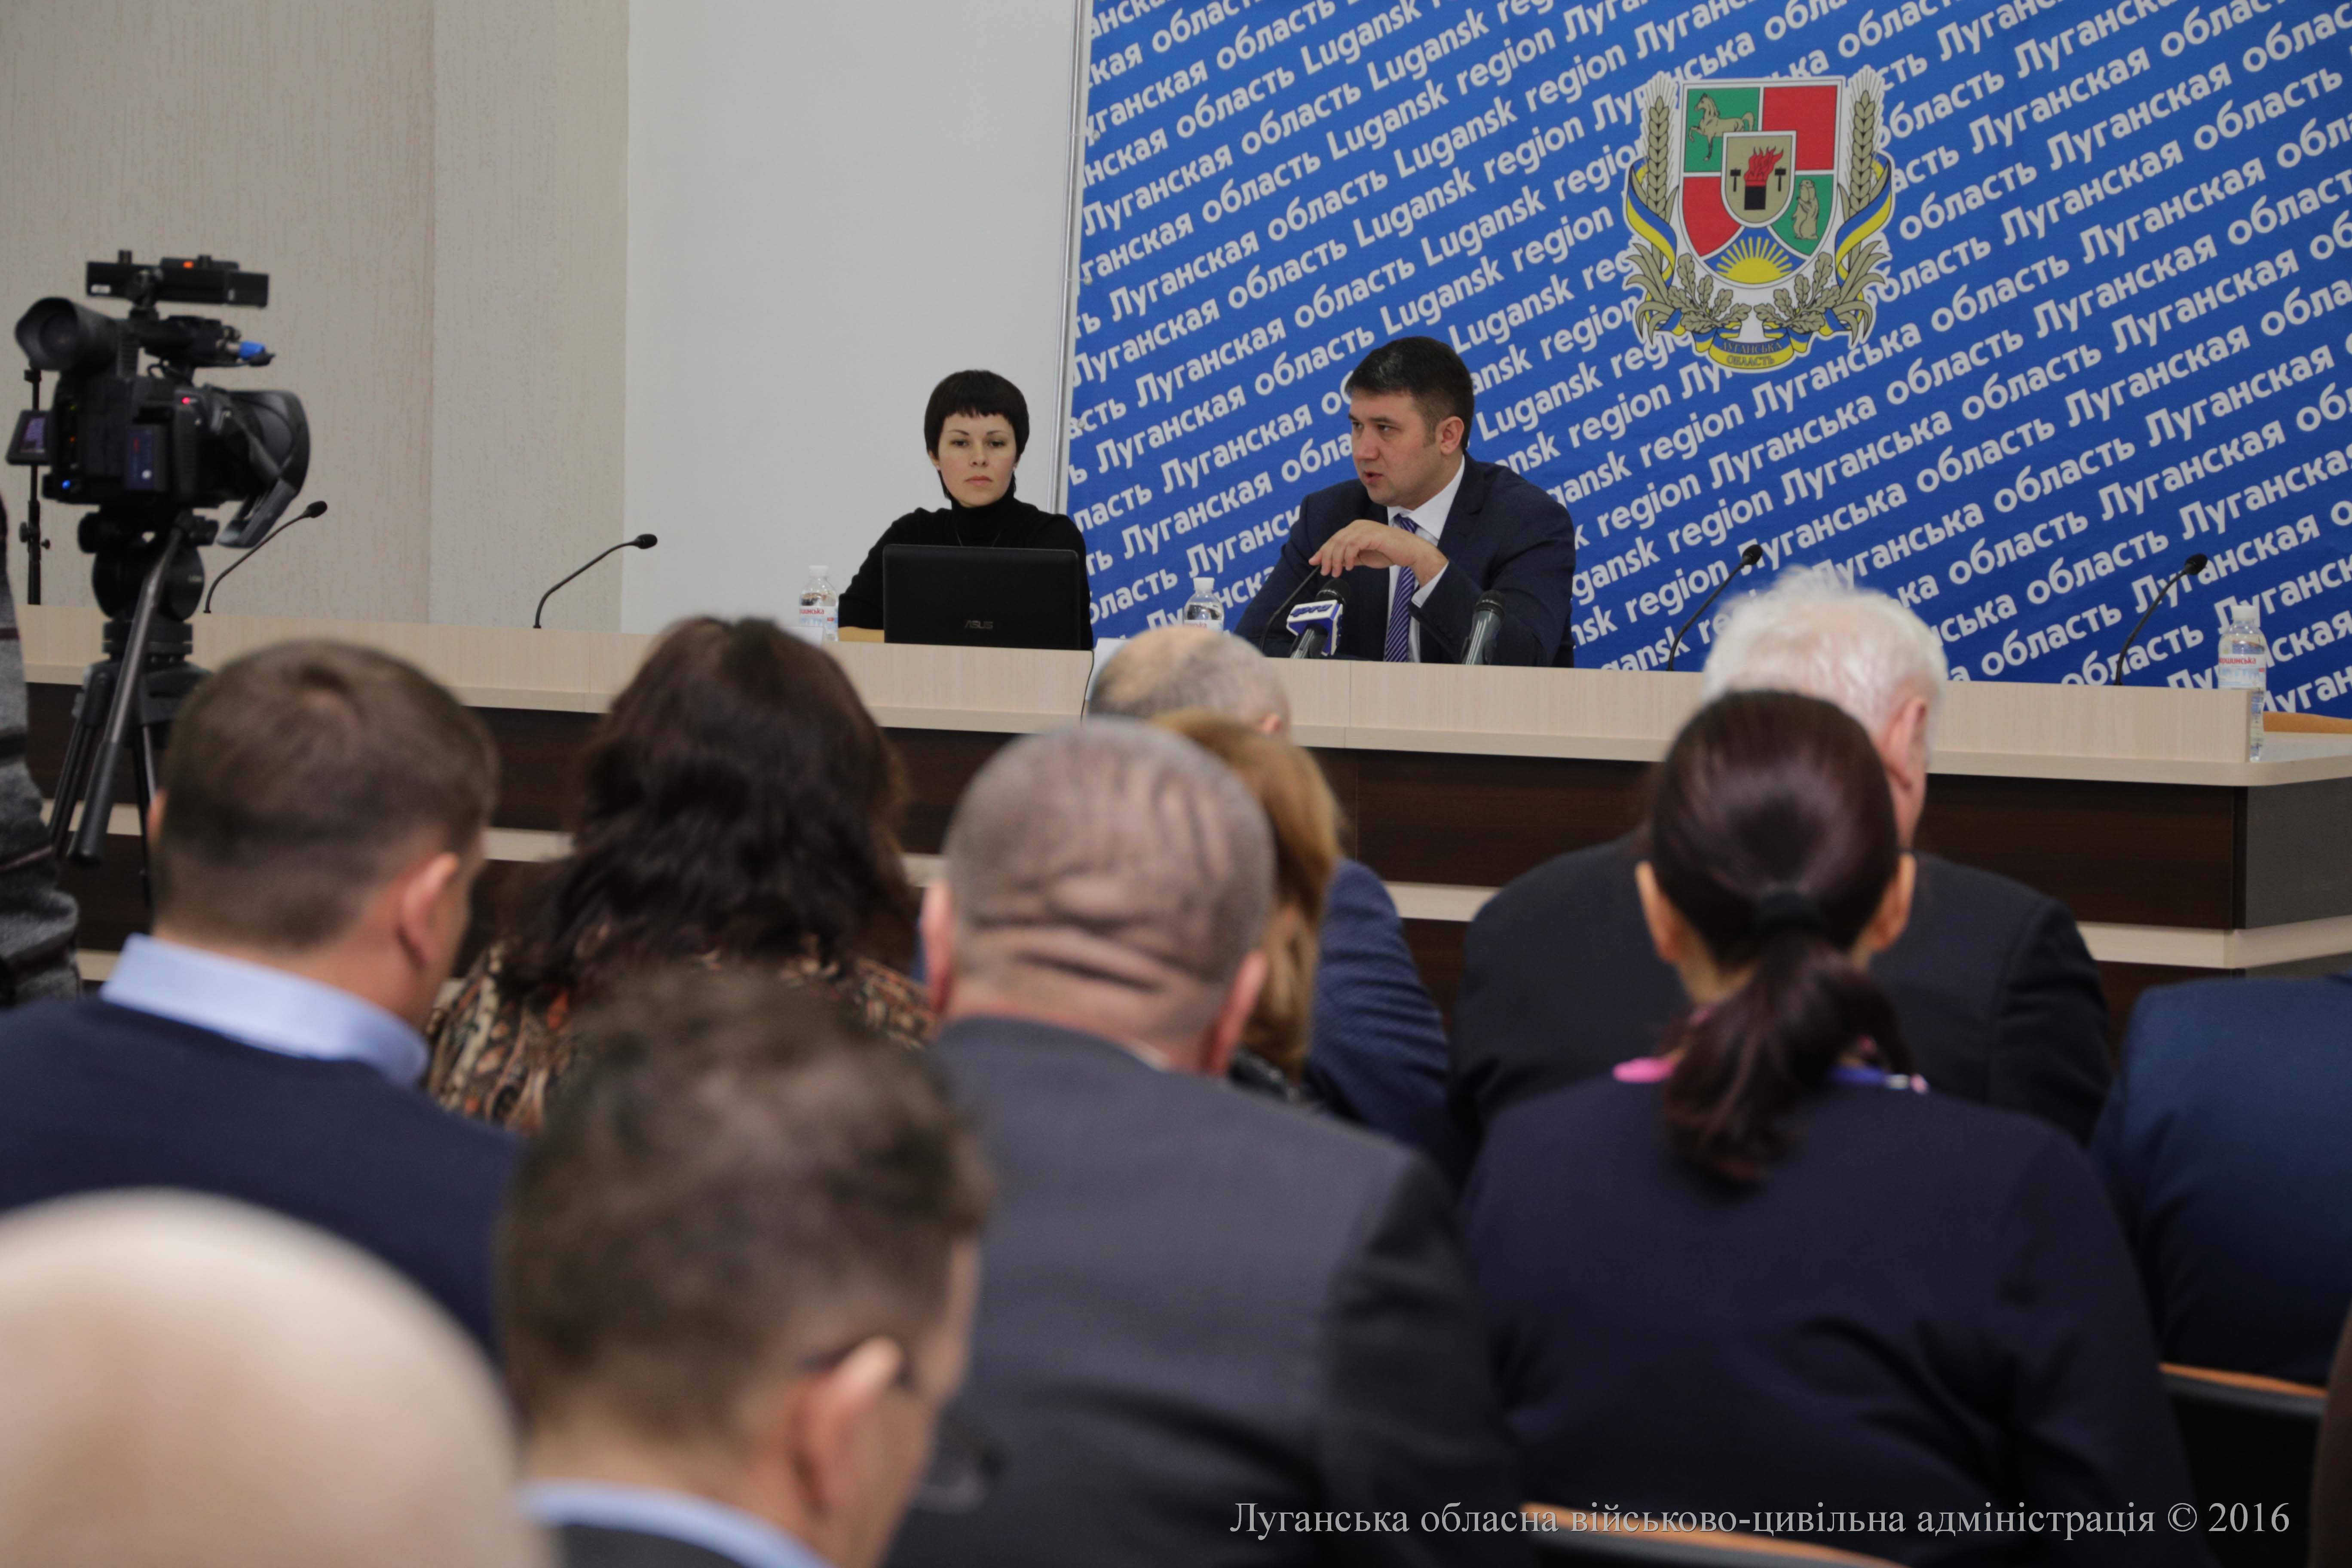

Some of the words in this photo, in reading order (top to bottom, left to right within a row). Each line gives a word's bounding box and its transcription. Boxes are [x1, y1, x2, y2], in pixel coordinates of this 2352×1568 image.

[1083, 127, 1168, 188] нская
[1176, 67, 1295, 138] область
[1301, 0, 1422, 75] Lugansk
[1152, 0, 1261, 53] облас
[1216, 0, 1336, 70] область
[1838, 0, 1951, 58] облас
[1969, 46, 2150, 154] Луганская
[2161, 0, 2285, 57] облас
[1084, 144, 1233, 236] Луганская
[1241, 83, 1361, 155] область
[1367, 8, 1490, 91] Lugansk
[1109, 230, 1259, 322] Луганская
[1268, 170, 1388, 241] область
[1393, 96, 1518, 178] Lugansk
[1525, 45, 1627, 113] region
[1202, 152, 1321, 223] область
[1326, 79, 1449, 160] Lugansk
[1456, 28, 1556, 95] region
[1899, 162, 2037, 240] область
[2047, 62, 2232, 171] Луганская
[2001, 140, 2184, 245] Луганская
[2194, 68, 2343, 150] область
[1075, 298, 1220, 388] Луганская
[1228, 239, 1348, 309] область
[1353, 167, 1476, 248] Lugansk
[1483, 116, 1585, 183] region
[1136, 318, 1286, 408] Луганская
[1294, 258, 1415, 328] область
[1421, 185, 1546, 266] Lugansk
[1448, 274, 1575, 355] Lugansk
[1639, 403, 1744, 468] region
[1752, 323, 1922, 419] Луганська
[1931, 255, 2070, 332] область
[2080, 157, 2266, 264] Луганская
[1096, 385, 1246, 474] Луганская
[1255, 327, 1375, 395] область
[1380, 256, 1504, 336] Lugansk
[1512, 206, 1614, 272] region
[1476, 361, 1603, 441] Lugansk
[1568, 384, 1672, 448] region
[1597, 474, 1701, 537] region
[1709, 395, 1877, 489] Луганська
[1886, 330, 2024, 405] область
[2033, 234, 2217, 338] Луганская
[1668, 490, 1773, 554] region
[1781, 411, 1952, 505] Луганська
[1962, 344, 2101, 420] область
[2111, 249, 2299, 353] Луганская
[1161, 404, 1313, 494] Луганская
[1625, 560, 1729, 622] region
[1917, 419, 2055, 492] область
[2065, 325, 2251, 427] Луганская
[1949, 511, 2088, 585] область
[2098, 420, 2285, 521] Луганская
[1994, 438, 2135, 512] область
[2145, 345, 2335, 447] Луганская
[1121, 471, 1273, 560] Луганская
[2027, 530, 2168, 604] область
[964, 620, 993, 629] ASUS
[1981, 604, 2122, 676] область
